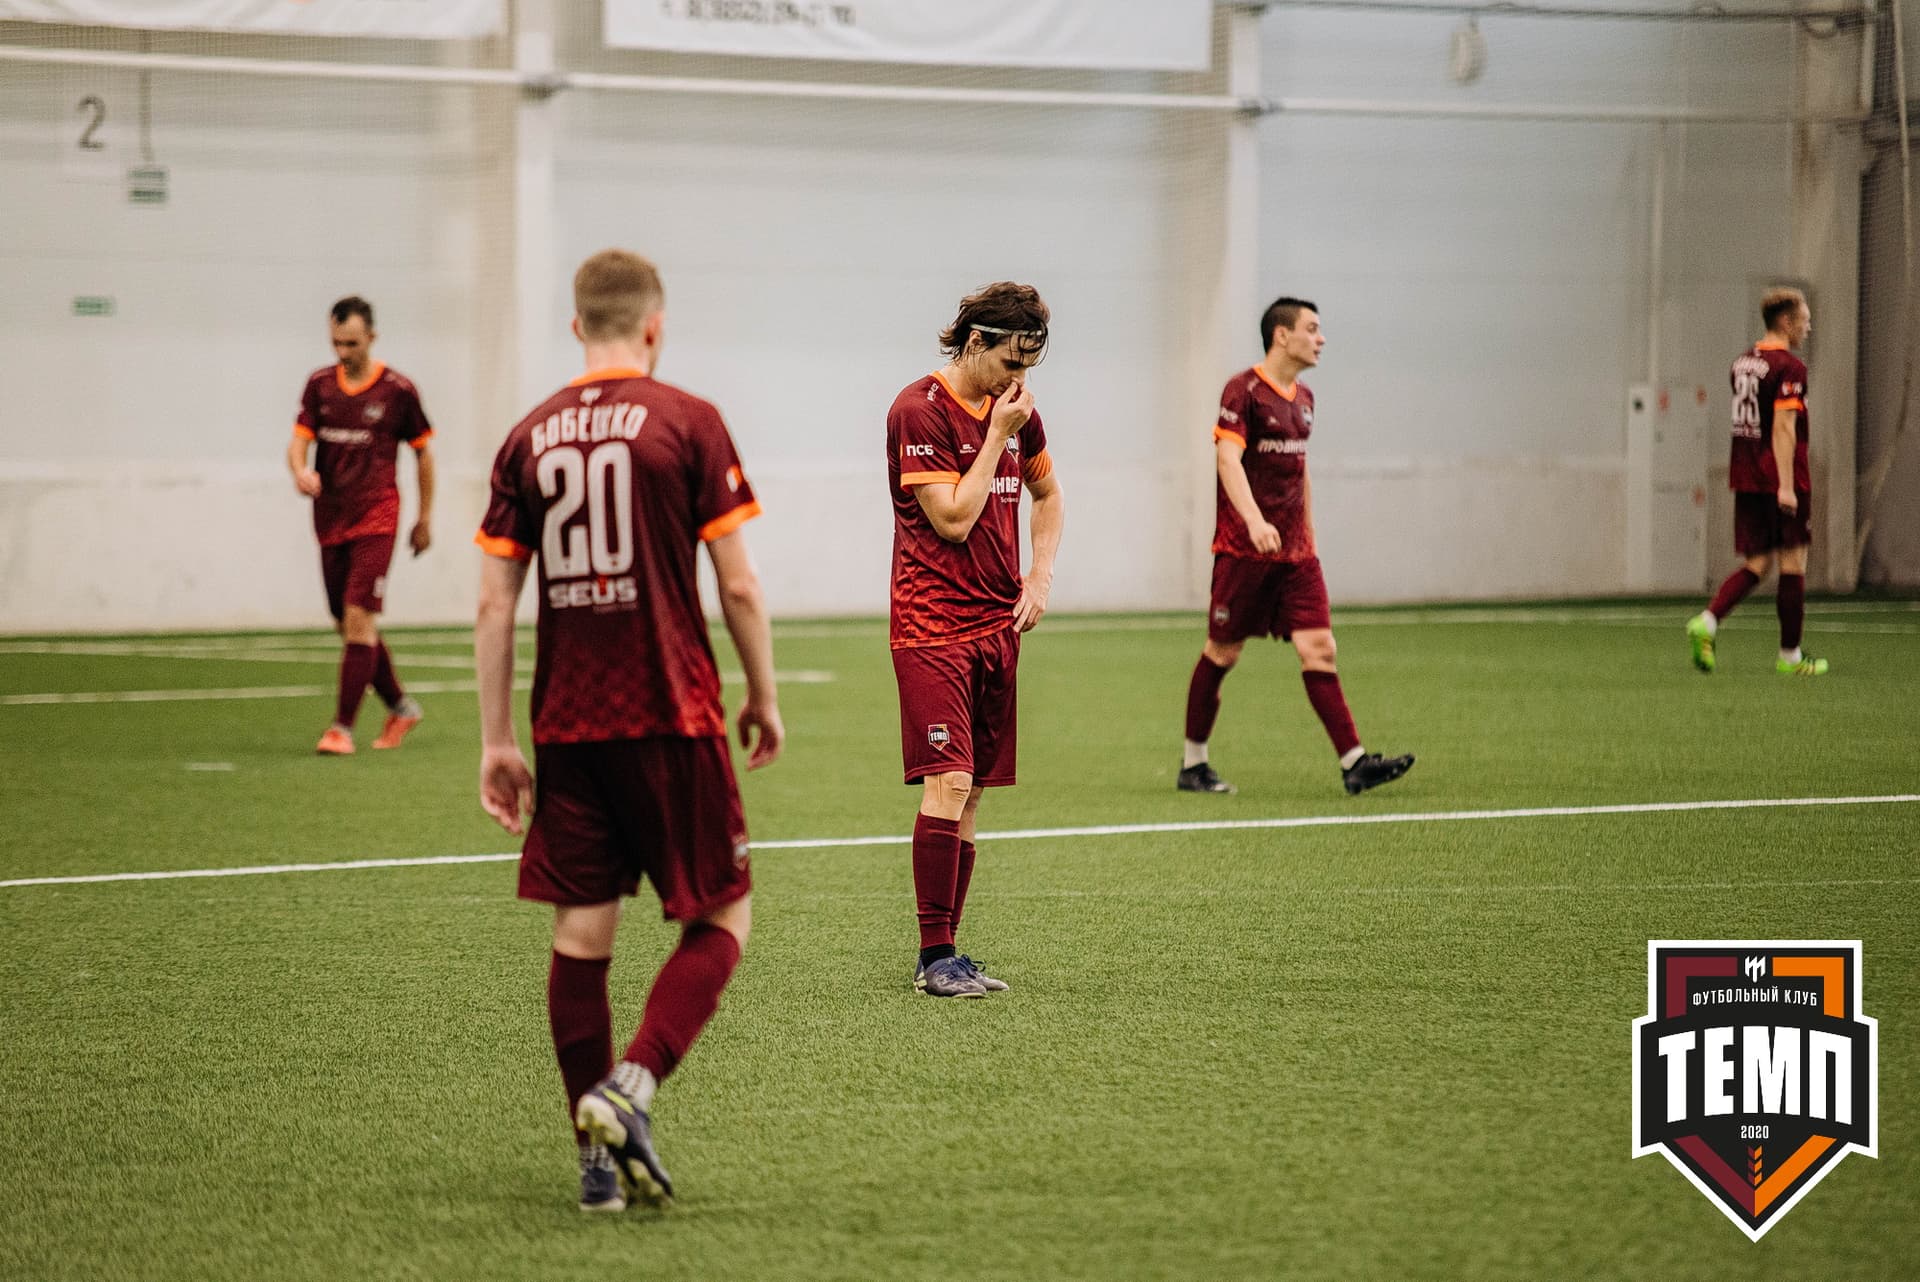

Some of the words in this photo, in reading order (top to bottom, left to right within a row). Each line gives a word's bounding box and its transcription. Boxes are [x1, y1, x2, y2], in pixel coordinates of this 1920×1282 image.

[78, 96, 105, 150] 2
[905, 444, 935, 457] ПСБ
[538, 441, 633, 578] 20
[548, 577, 638, 609] SEUS
